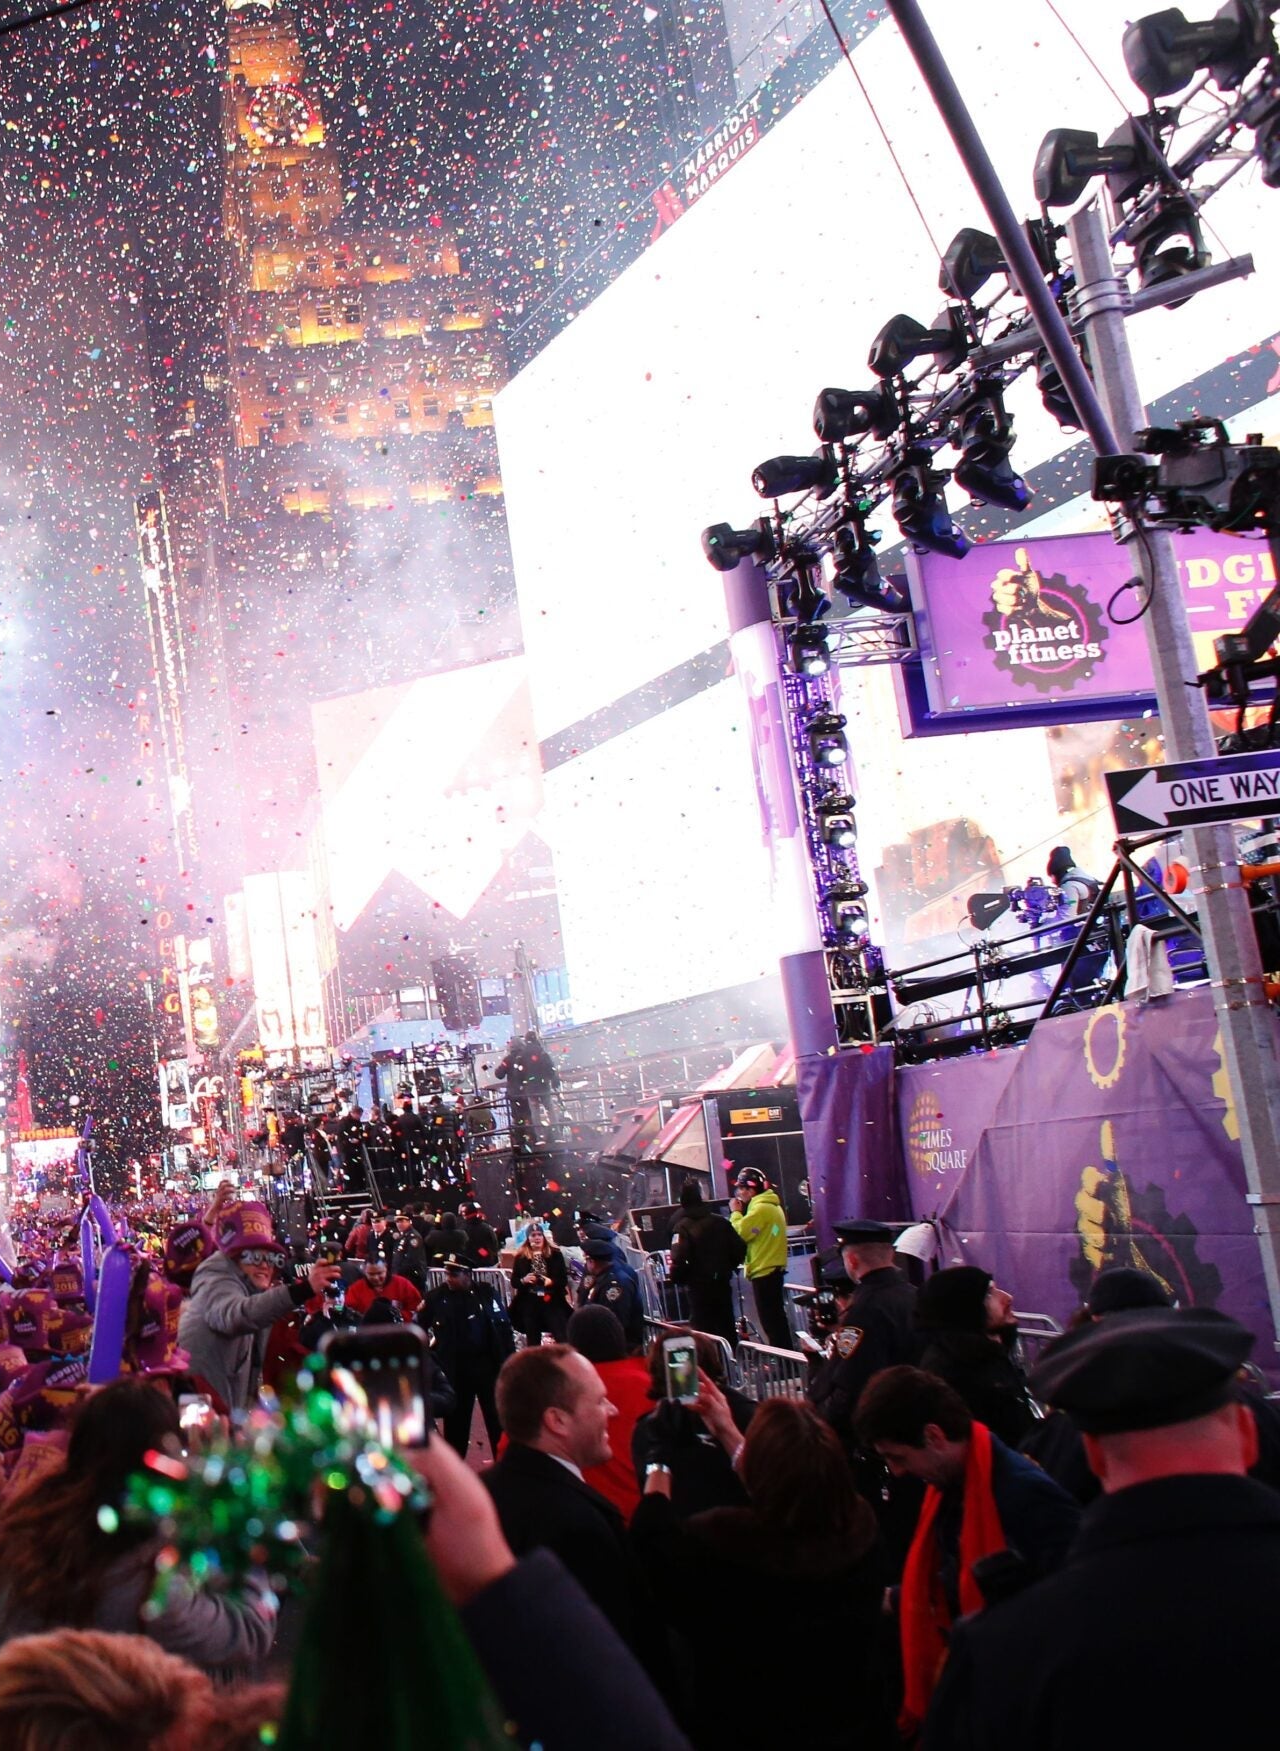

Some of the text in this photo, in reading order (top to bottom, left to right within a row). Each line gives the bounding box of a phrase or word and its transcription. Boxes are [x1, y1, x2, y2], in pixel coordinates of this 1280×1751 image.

[684, 91, 761, 180] MARRIOTT
[686, 126, 754, 200] MARQUIS
[992, 620, 1080, 652] planet
[1008, 640, 1102, 665] fitness
[1171, 771, 1280, 807] ONE WAY
[20, 1126, 75, 1140] TOSHIBA
[922, 1129, 952, 1149] TIMES
[925, 1149, 967, 1173] SQUARE
[55, 1279, 79, 1293] 2016
